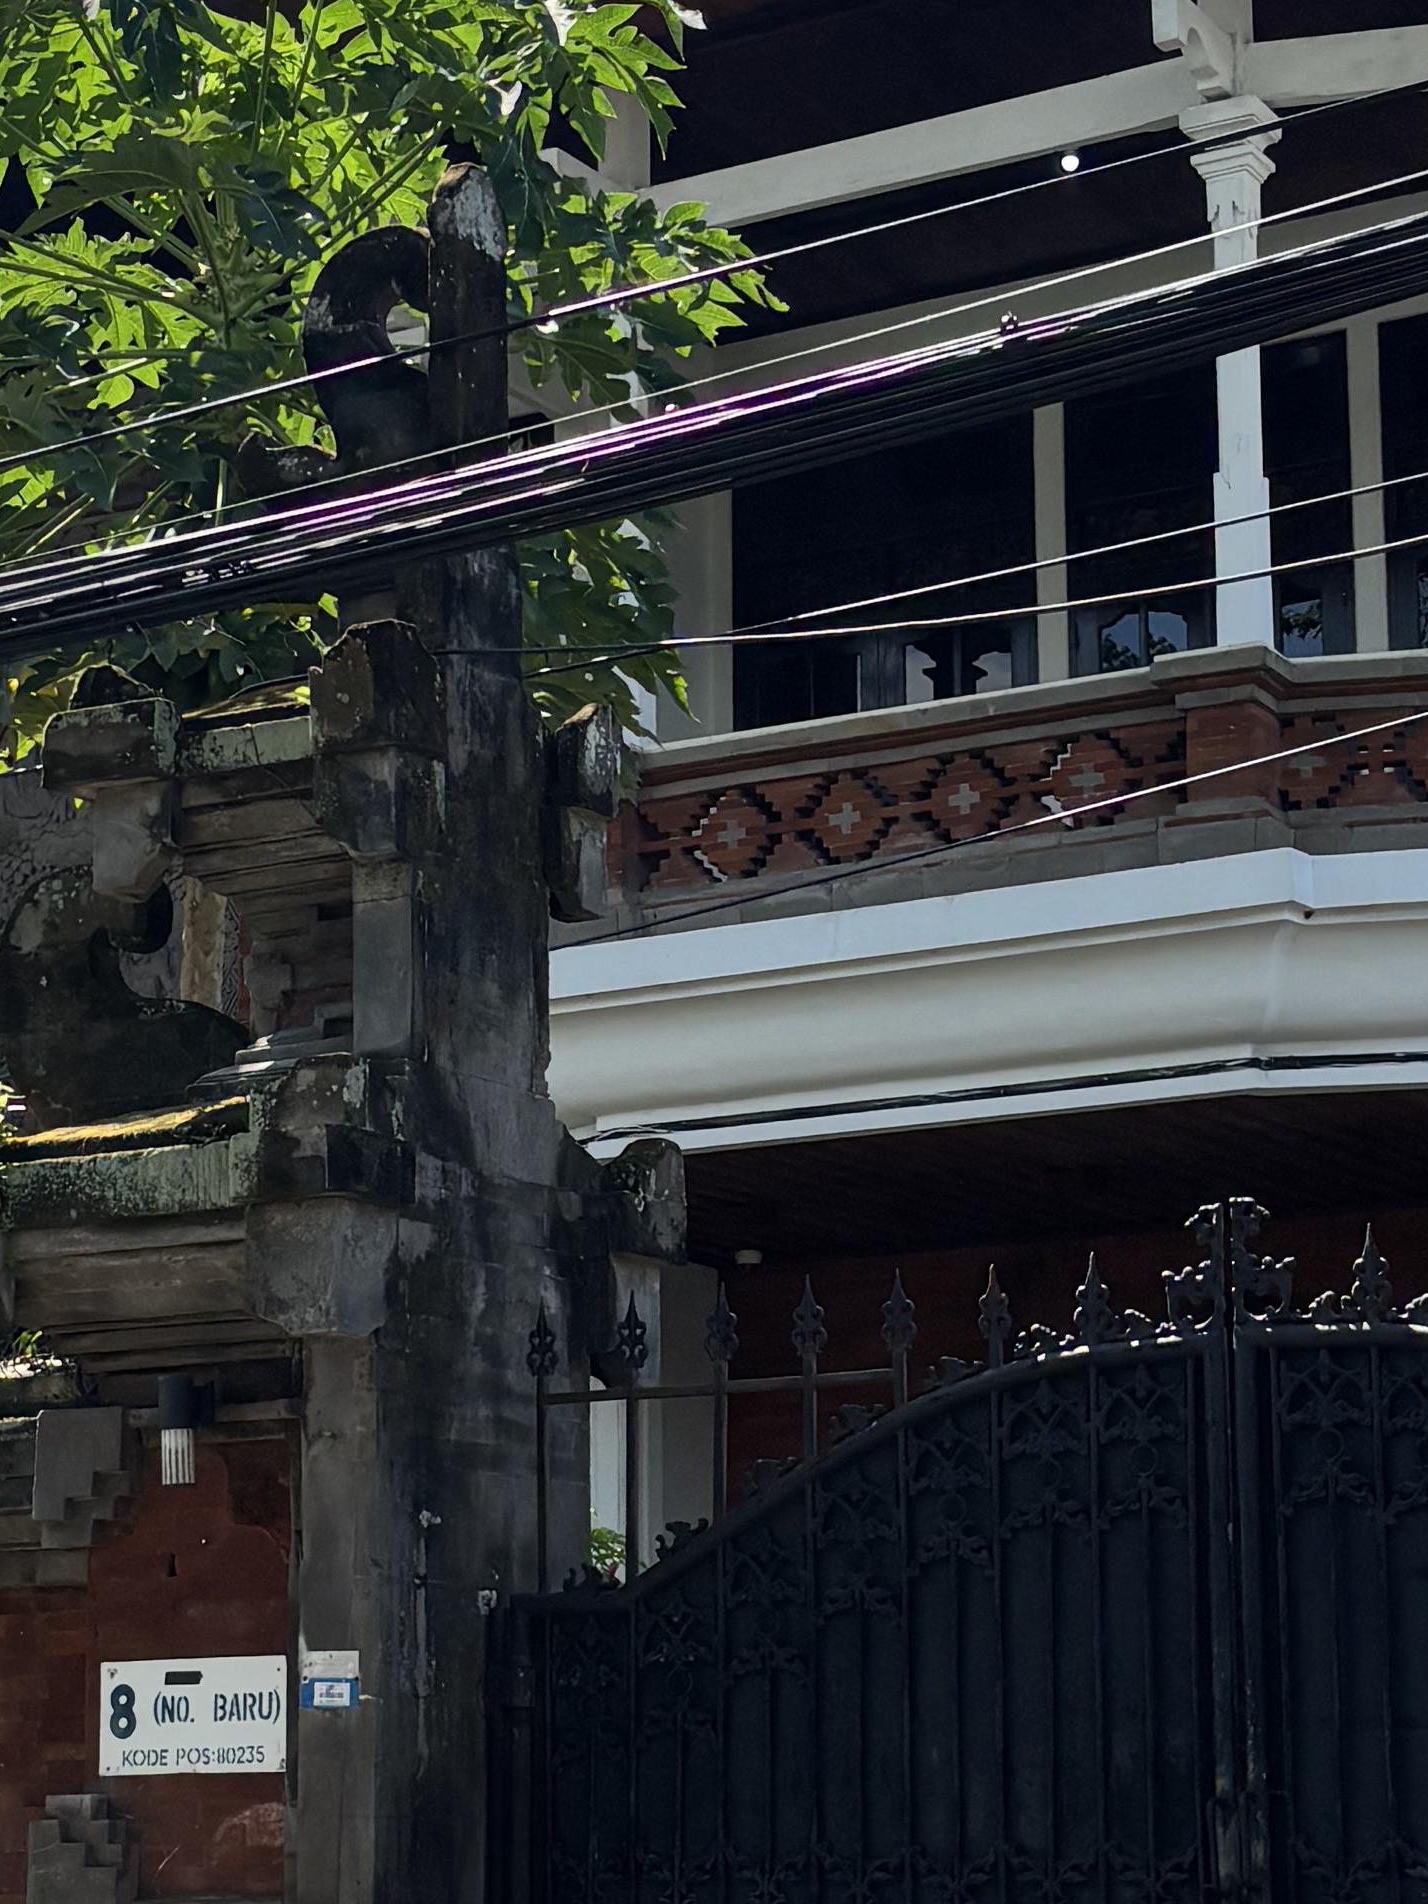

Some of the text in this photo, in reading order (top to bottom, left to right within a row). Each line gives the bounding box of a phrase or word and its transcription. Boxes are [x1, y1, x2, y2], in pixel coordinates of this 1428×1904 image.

[110, 1683, 136, 1739] 8
[153, 1691, 195, 1726] (NO.
[213, 1689, 281, 1725] BARU)
[122, 1745, 265, 1767] KODE POS:80235
